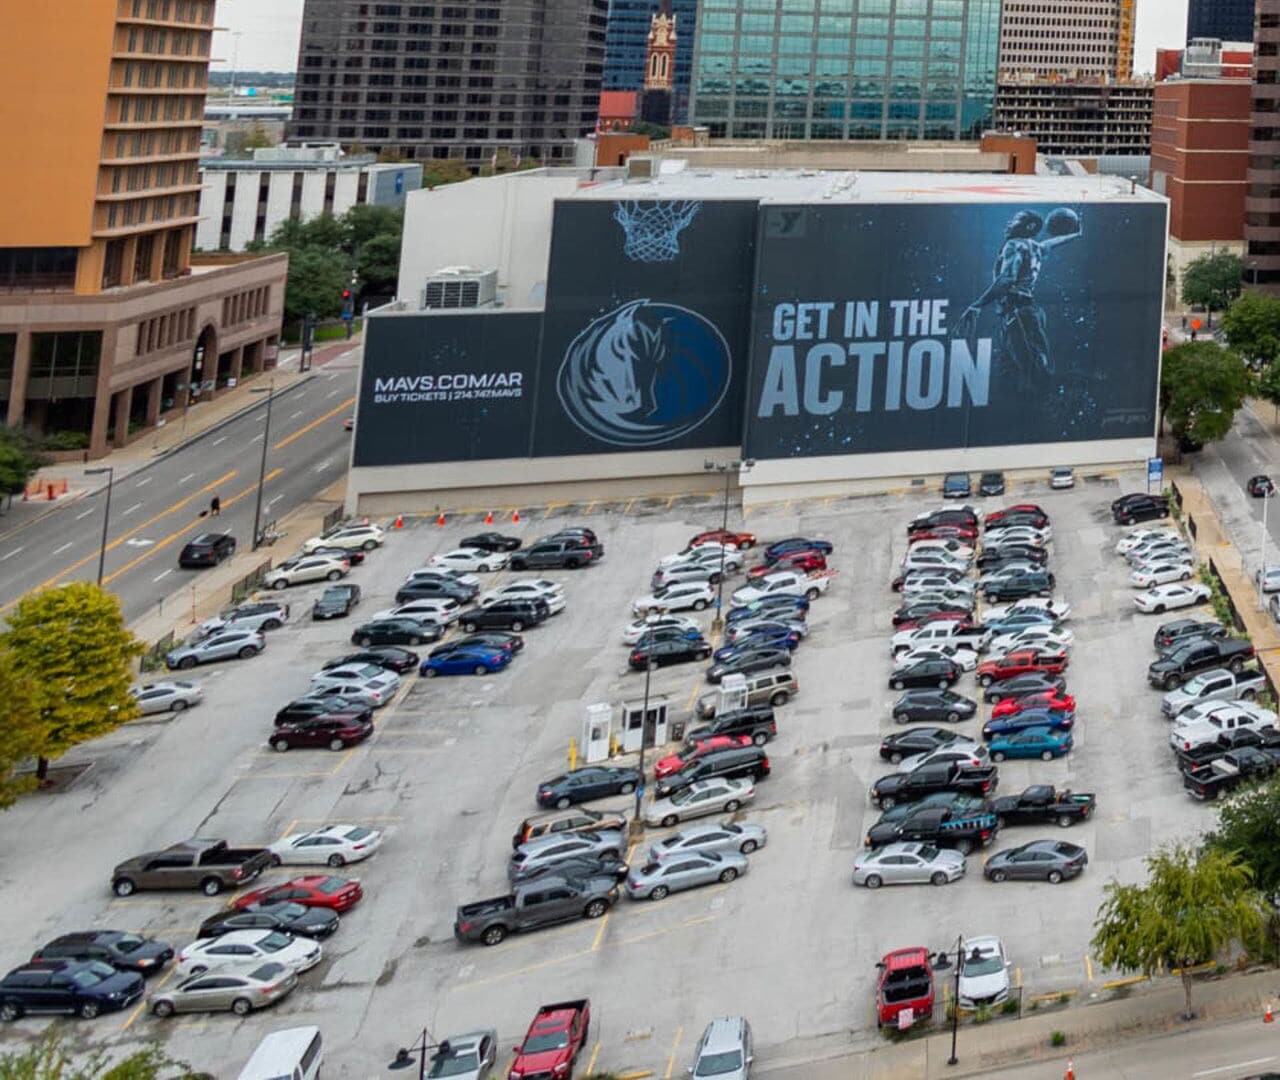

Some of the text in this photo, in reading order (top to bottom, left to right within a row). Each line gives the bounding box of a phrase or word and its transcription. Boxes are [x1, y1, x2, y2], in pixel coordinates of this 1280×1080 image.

[772, 299, 949, 341] GET IN THE
[374, 372, 523, 392] MAVS.COM/AR
[757, 338, 993, 417] ACTION
[374, 393, 399, 403] BUY
[401, 391, 446, 402] TICKETS
